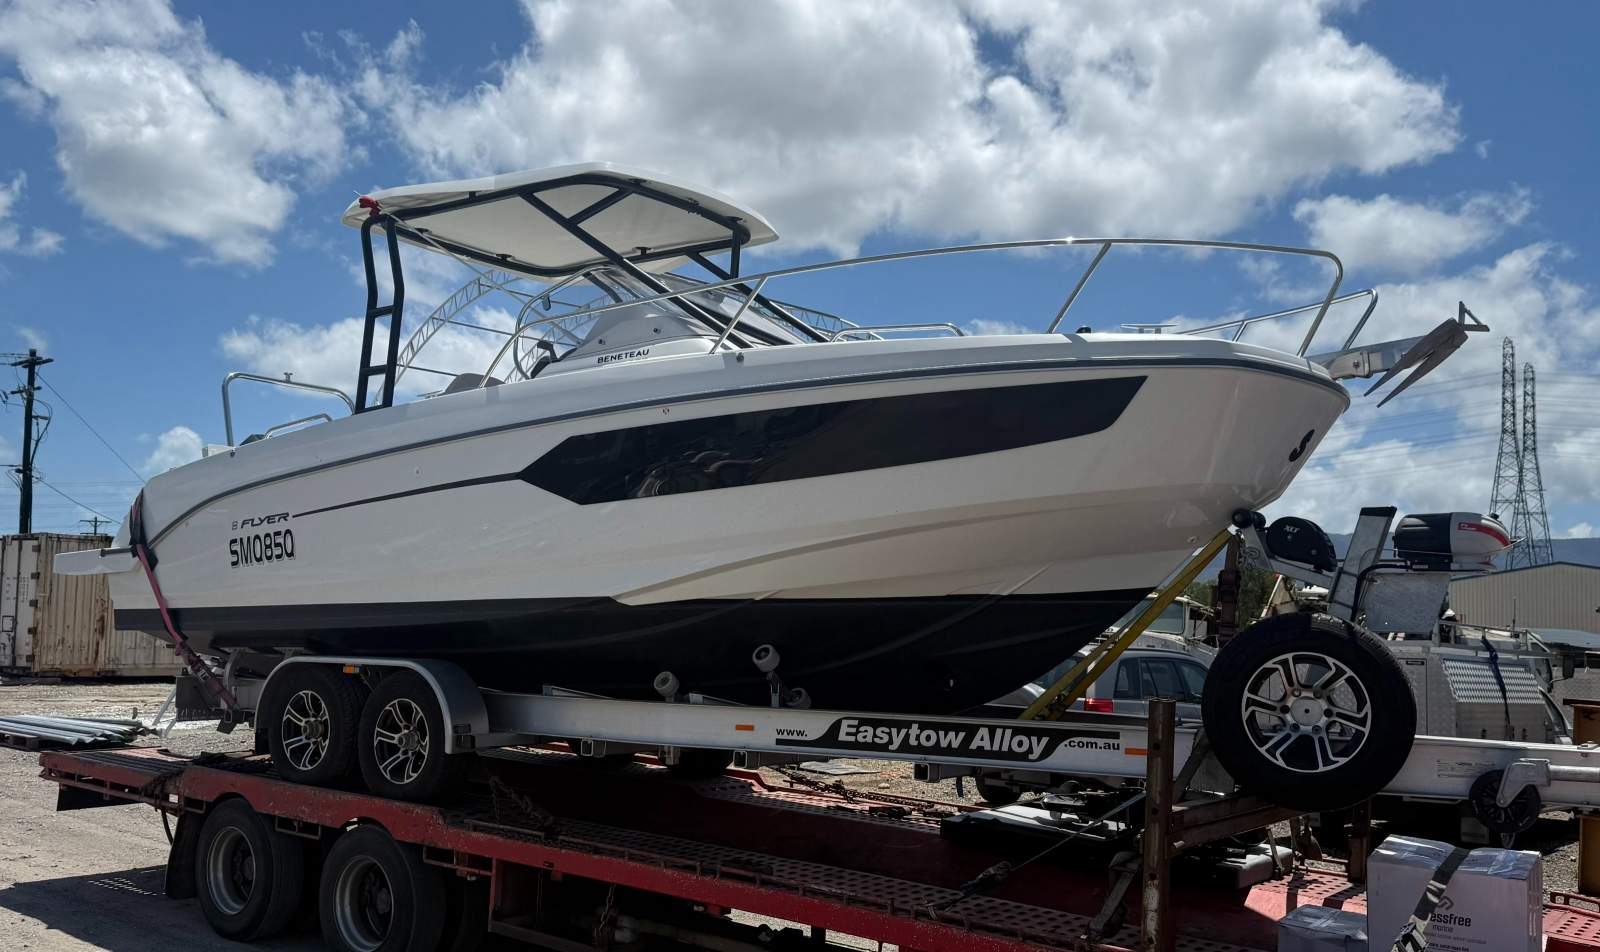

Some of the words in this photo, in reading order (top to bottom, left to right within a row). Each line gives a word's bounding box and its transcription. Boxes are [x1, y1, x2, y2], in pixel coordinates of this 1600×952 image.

[597, 349, 650, 364] BENETEAU
[240, 512, 290, 529] FLYER
[776, 728, 808, 738] www.
[838, 719, 966, 751] Easytow
[969, 726, 1050, 760] Alloy
[1064, 739, 1121, 751] .com.au
[1430, 912, 1472, 927] essfree
